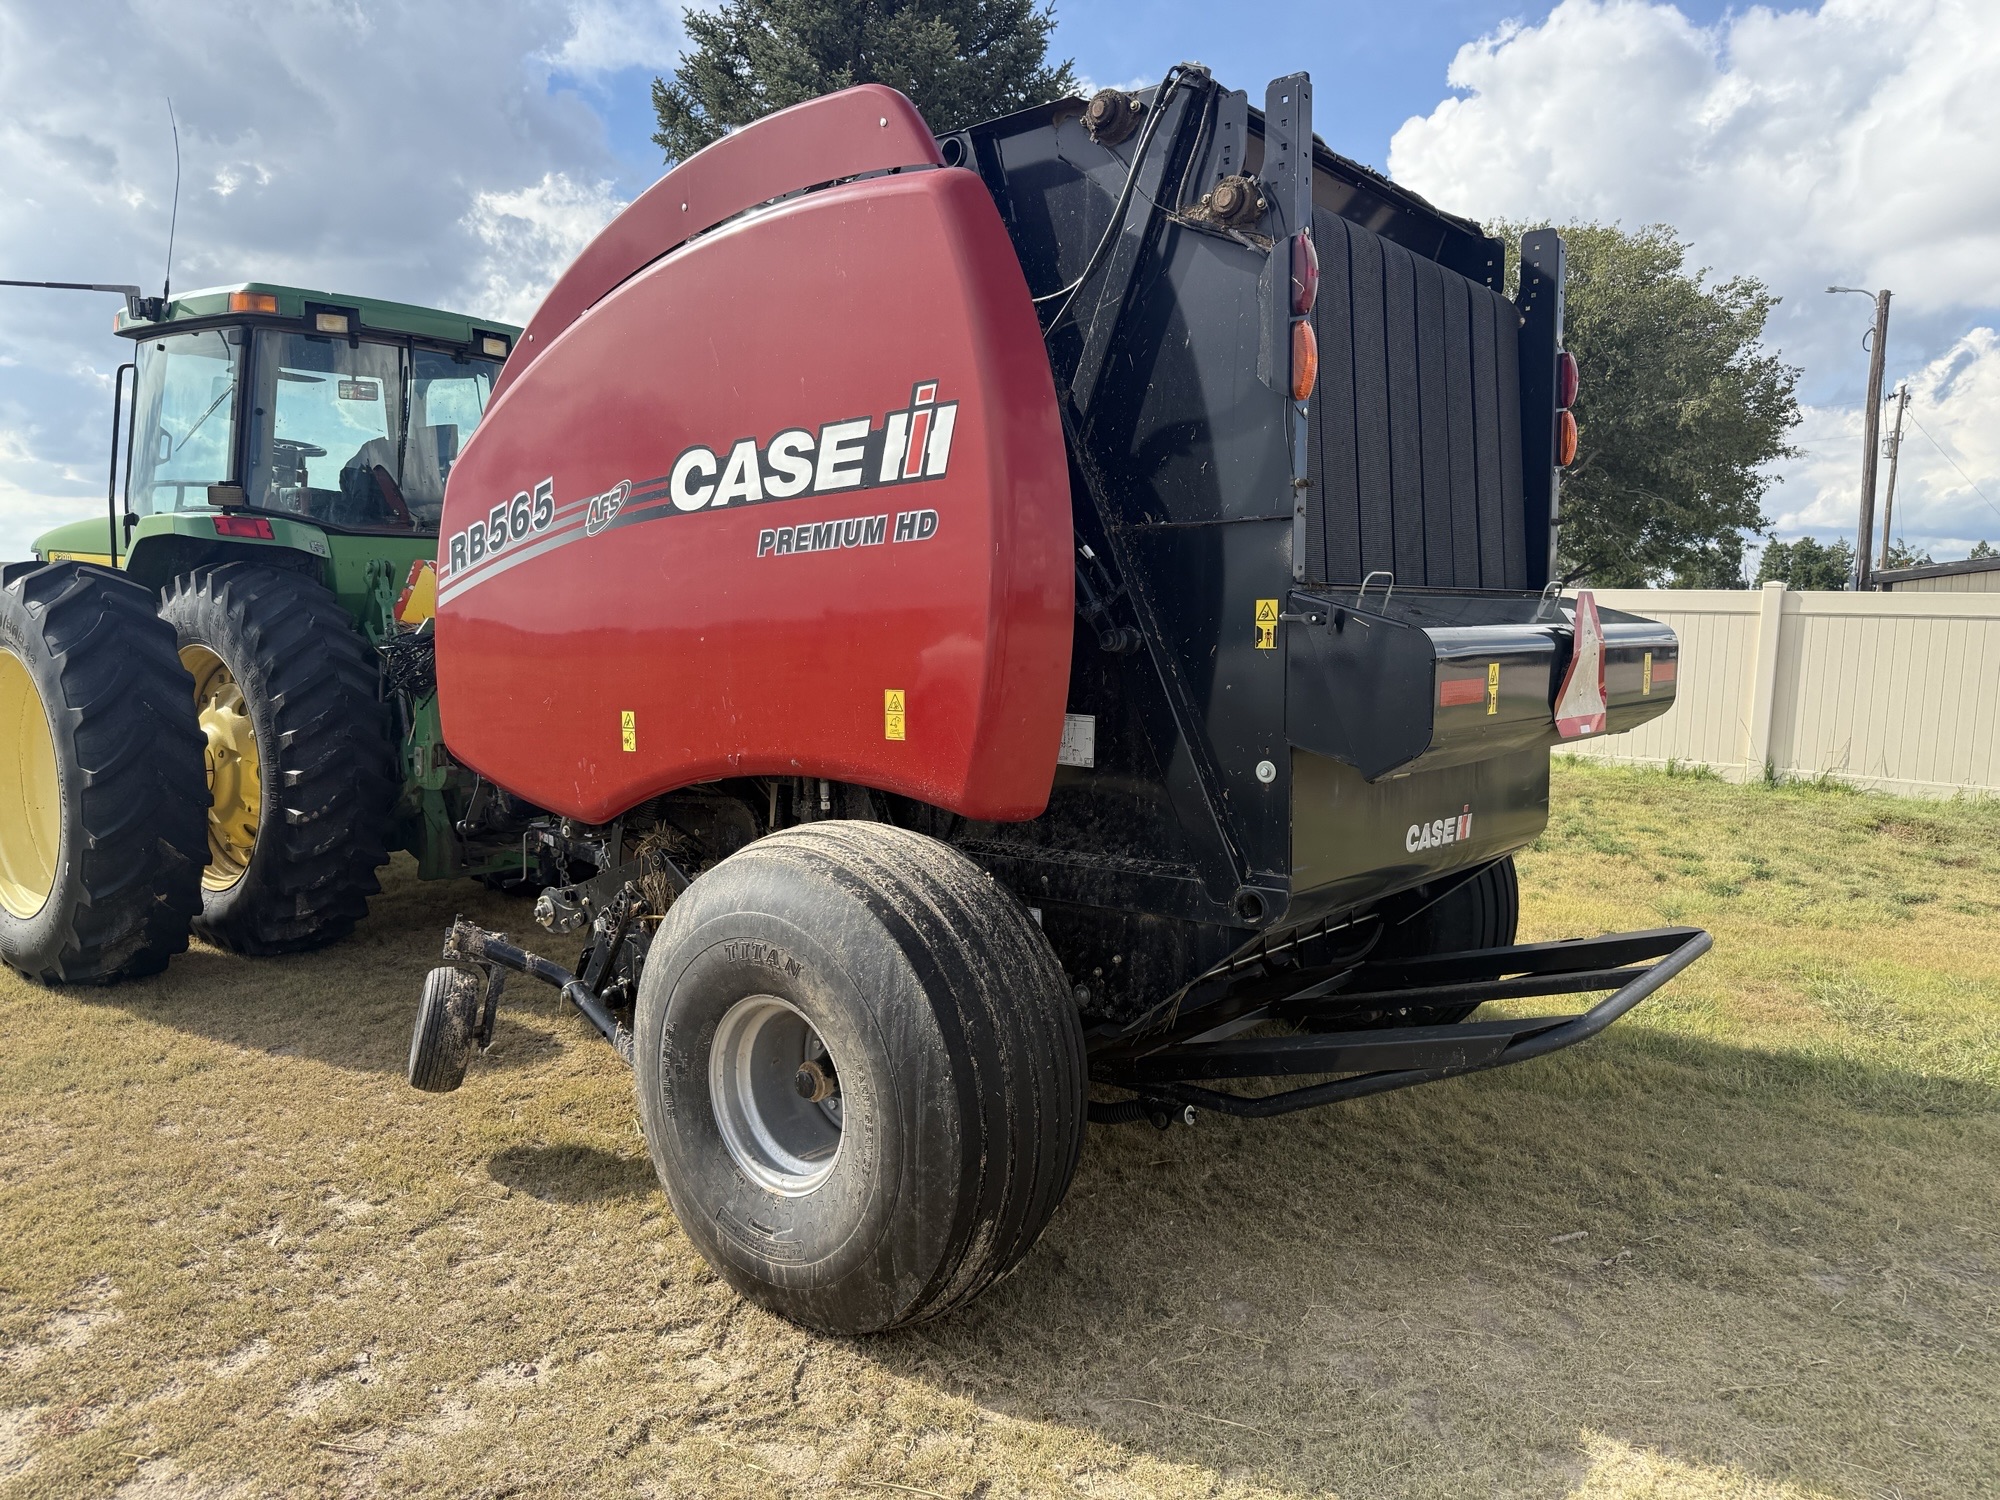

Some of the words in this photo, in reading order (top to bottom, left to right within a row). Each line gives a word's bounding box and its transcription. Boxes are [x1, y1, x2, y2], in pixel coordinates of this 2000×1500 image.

[669, 416, 871, 512] CASE
[449, 476, 556, 579] RB565
[586, 487, 622, 528] AFS
[757, 514, 888, 558] PREMIUM
[893, 508, 938, 543] HD
[1405, 816, 1456, 853] CASE
[724, 941, 804, 979] TITAN
